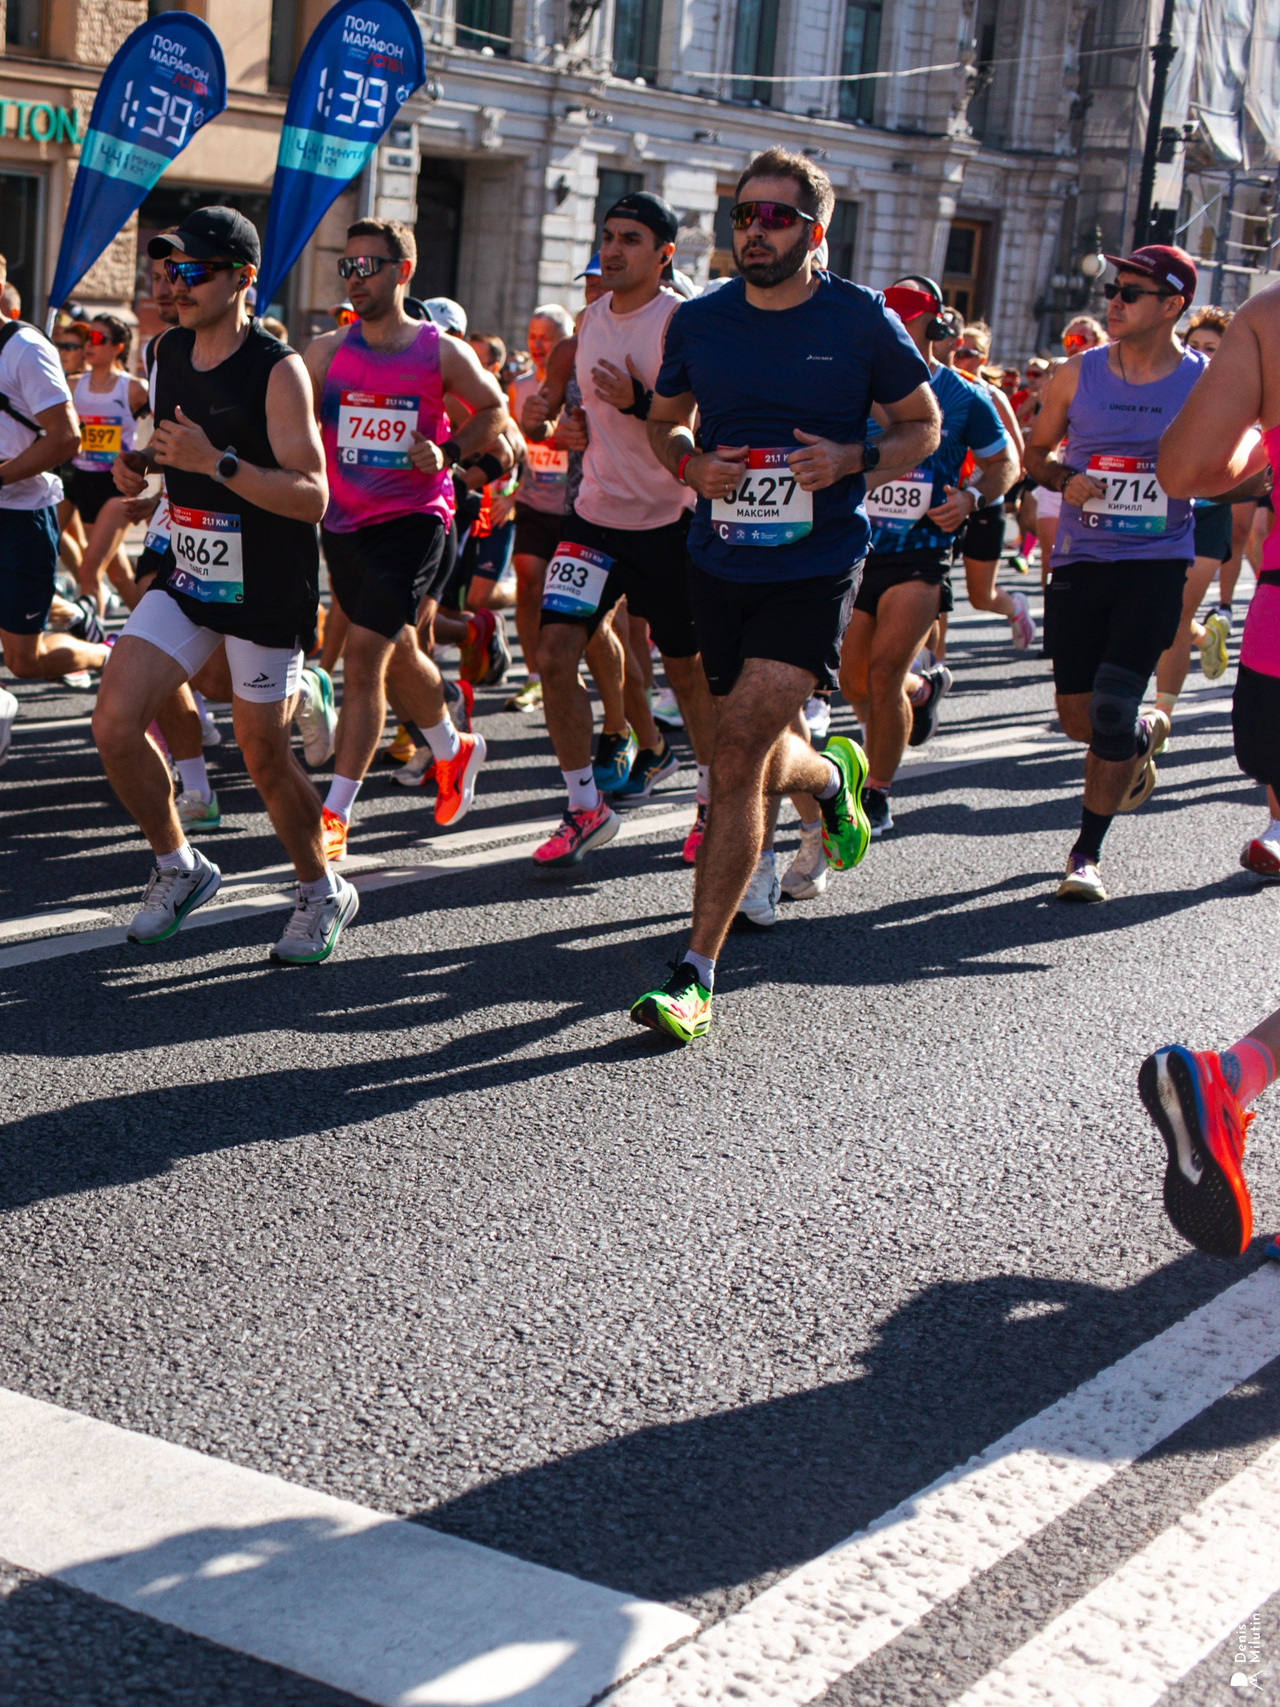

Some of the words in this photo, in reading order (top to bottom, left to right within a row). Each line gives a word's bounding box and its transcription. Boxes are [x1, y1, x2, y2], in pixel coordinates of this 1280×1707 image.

[345, 15, 380, 35] ПОЛУ
[152, 34, 187, 57] ПОЛУ
[342, 30, 404, 59] МАРАФОН
[149, 48, 209, 83] МАРАФОН
[317, 67, 388, 128] 1:39
[120, 80, 193, 147] 1:39
[1109, 403, 1136, 412] UNDER
[1138, 405, 1148, 413] BY
[349, 416, 406, 442] 7489
[765, 454, 780, 463] 21,1
[867, 485, 922, 508] 4038
[1108, 503, 1143, 511] КИРИЛЛ
[202, 516, 215, 526] 21,1
[215, 518, 229, 527] КМ
[736, 508, 780, 518] МАКСИМ
[878, 507, 908, 515] МИХАИЛ
[177, 531, 229, 567] 4862
[548, 561, 589, 588] 983
